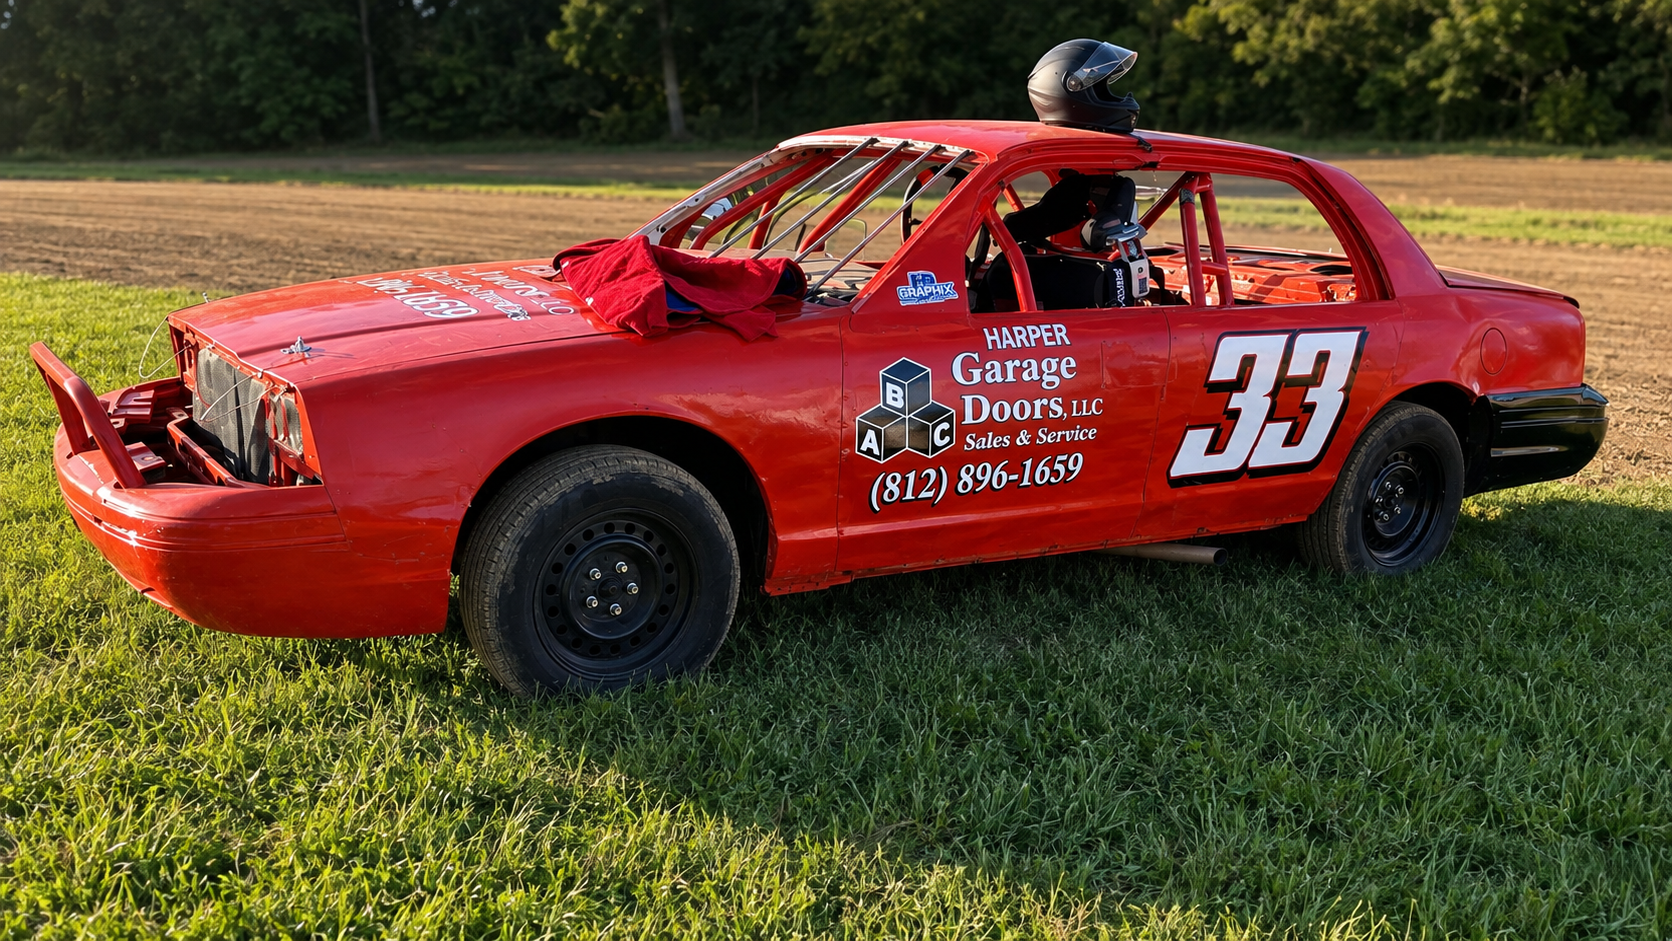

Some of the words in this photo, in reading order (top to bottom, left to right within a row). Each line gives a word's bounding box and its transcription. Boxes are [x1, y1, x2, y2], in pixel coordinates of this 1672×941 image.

[899, 284, 954, 298] GRAPHIX
[982, 323, 1071, 350] HARPER
[951, 351, 1077, 390] Garage
[885, 381, 905, 409] B
[1167, 327, 1369, 488] 33
[961, 394, 1068, 425] Doors,
[1071, 398, 1104, 418] LLC
[859, 429, 881, 456] A
[932, 421, 951, 448] C
[963, 431, 1011, 452] Sales
[1015, 429, 1032, 446] &
[1035, 425, 1098, 446] Service
[869, 465, 949, 514] (812)
[955, 452, 1084, 496] 896-1659
